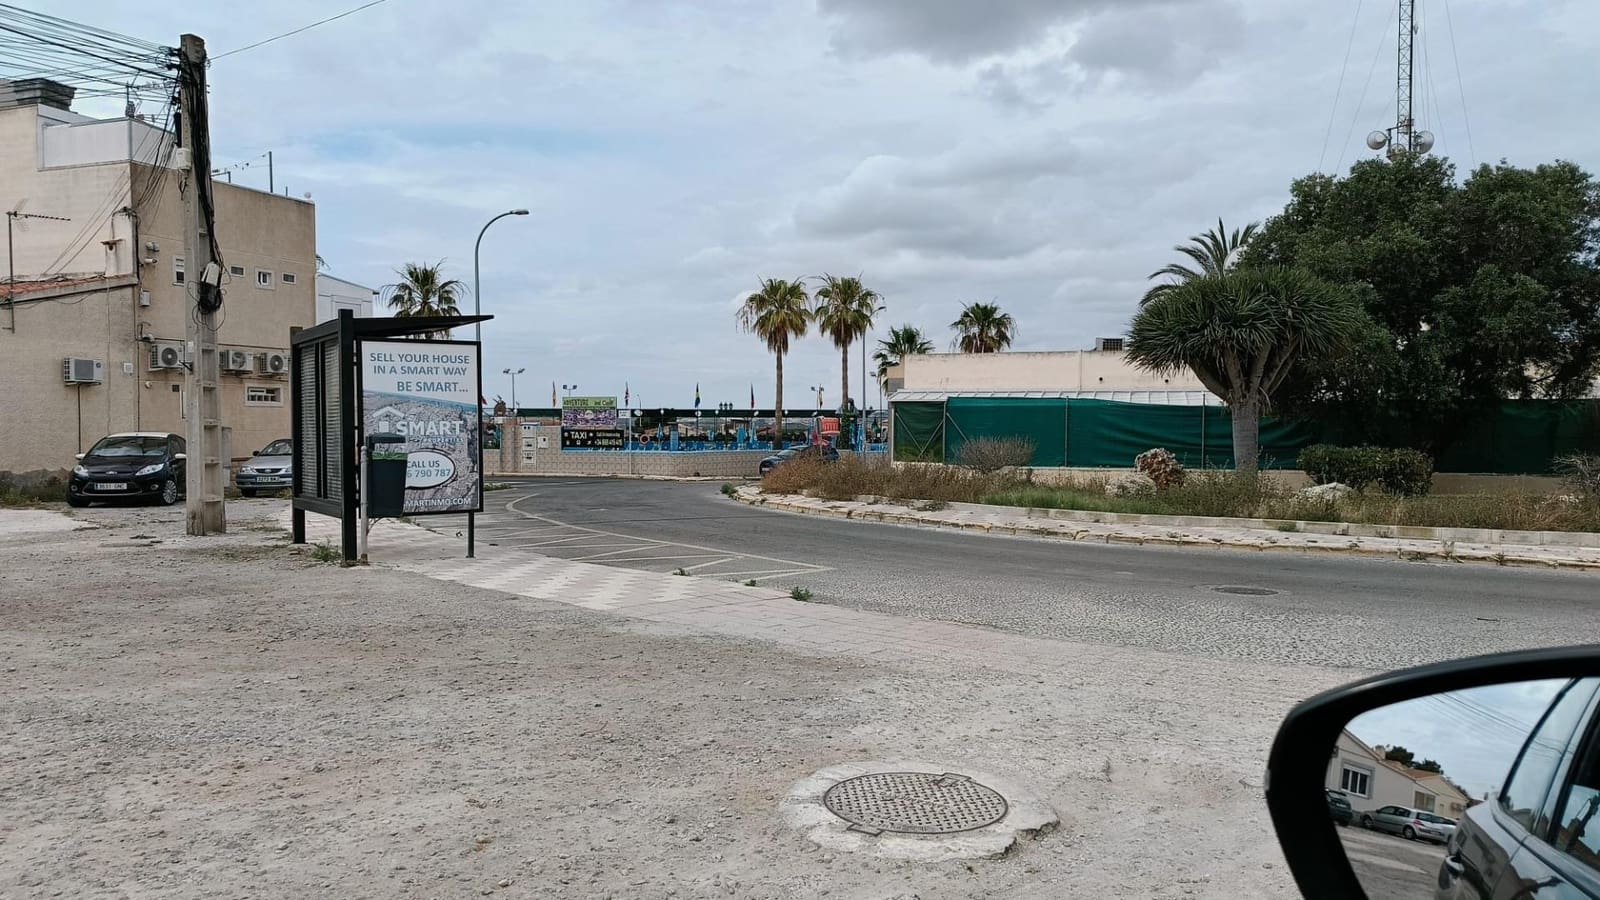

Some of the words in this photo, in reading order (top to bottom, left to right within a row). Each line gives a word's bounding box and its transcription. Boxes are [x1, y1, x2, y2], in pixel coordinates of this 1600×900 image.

[370, 352, 395, 362] SELL
[398, 353, 429, 363] YOUR
[432, 354, 470, 364] HOUSE
[373, 365, 386, 375] IN
[389, 365, 397, 375] A
[401, 365, 441, 375] SMART
[443, 366, 467, 376] WAY
[397, 381, 412, 392] BE
[416, 381, 469, 393] SMART...
[396, 420, 464, 436] SMART
[570, 431, 587, 440] TAXI
[428, 460, 440, 468] US
[414, 469, 432, 478] 790
[435, 469, 451, 477] 787
